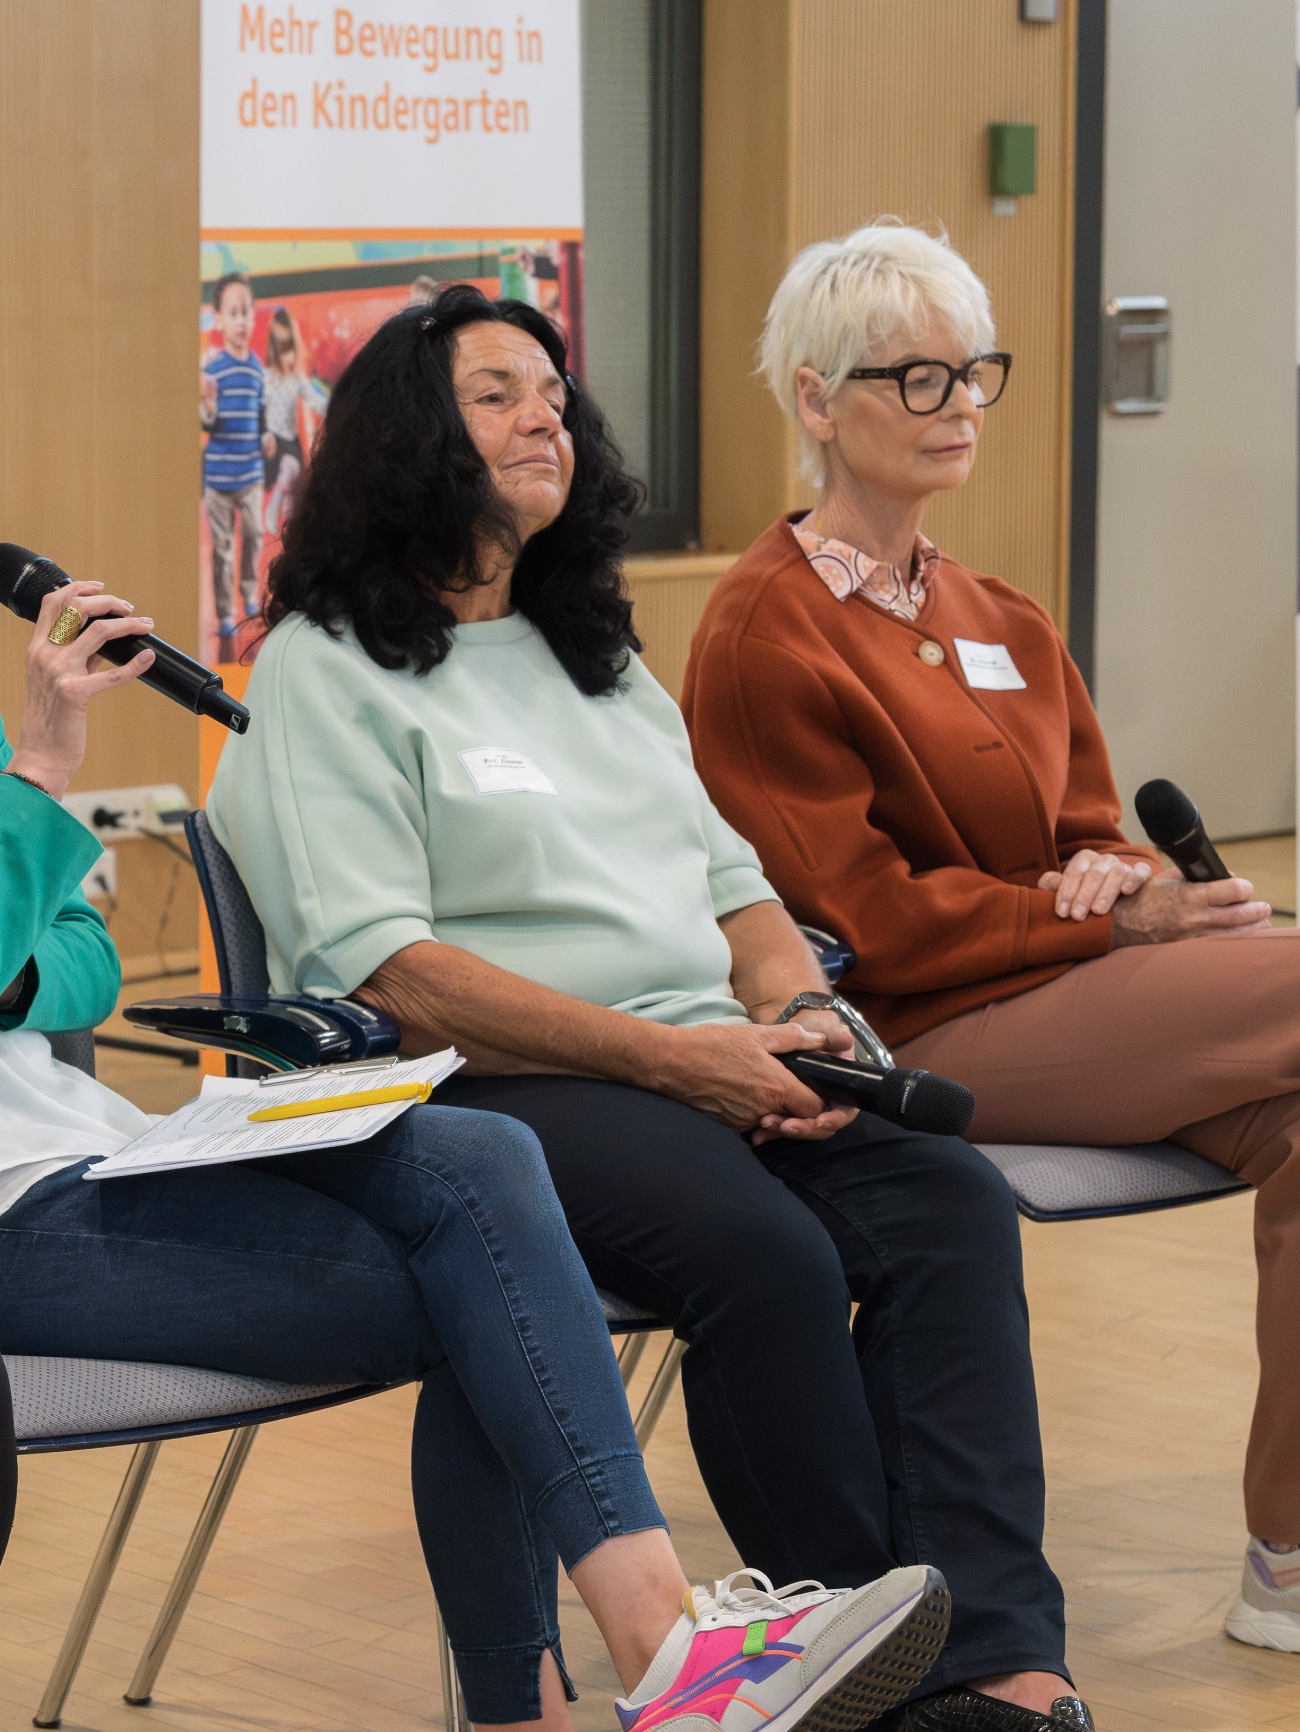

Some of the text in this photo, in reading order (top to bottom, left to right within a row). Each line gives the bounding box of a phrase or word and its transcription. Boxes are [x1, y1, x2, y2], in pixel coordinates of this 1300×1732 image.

[239, 3, 542, 75] Mehr Bewegung in
[238, 77, 529, 145] den Kindergarten
